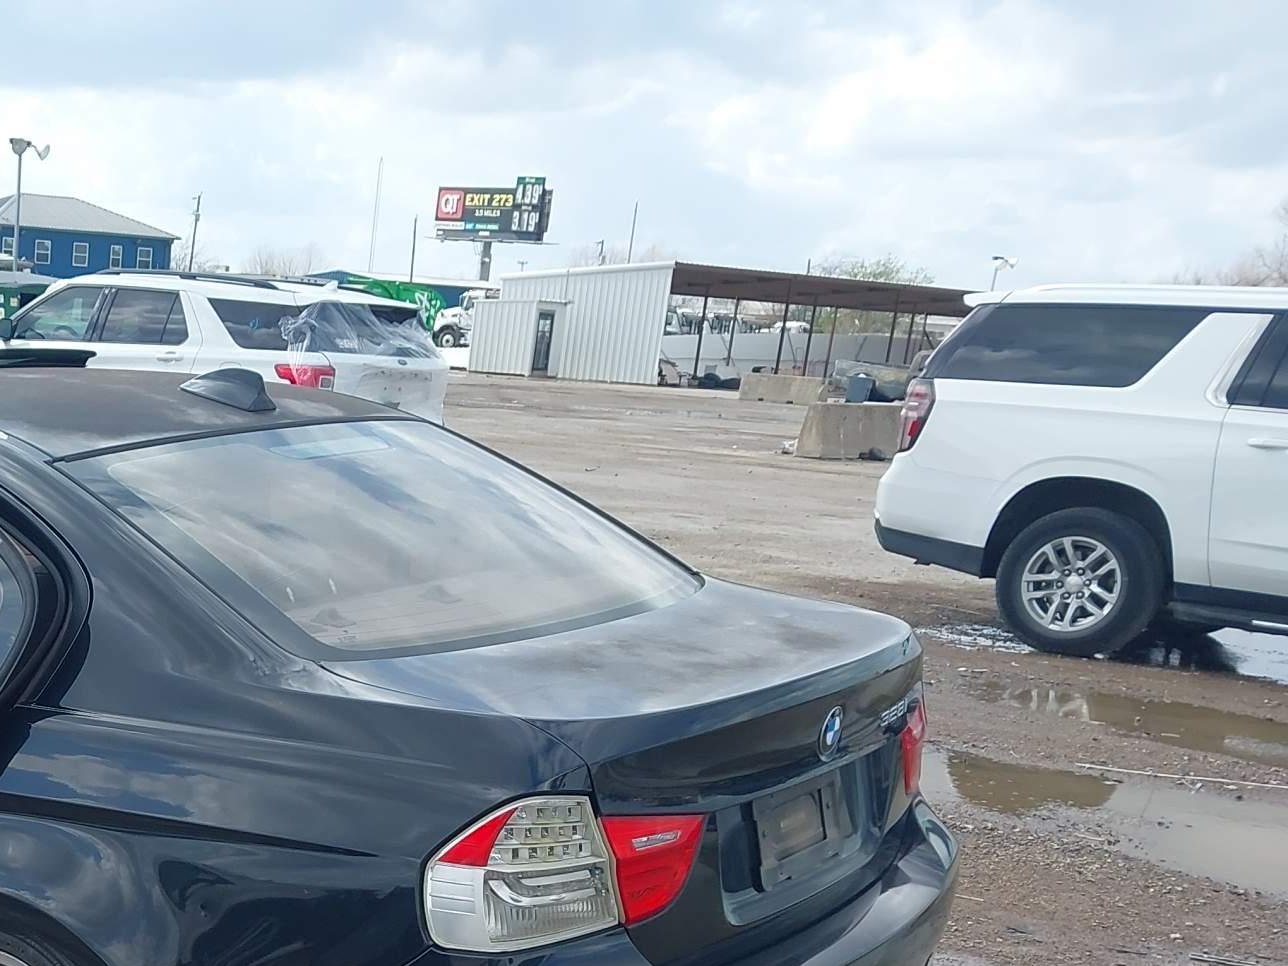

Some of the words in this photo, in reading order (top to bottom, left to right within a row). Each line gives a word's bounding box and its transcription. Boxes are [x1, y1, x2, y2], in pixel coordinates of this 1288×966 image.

[441, 194, 460, 216] QT
[465, 194, 490, 206] EXIT
[492, 194, 513, 207] 273
